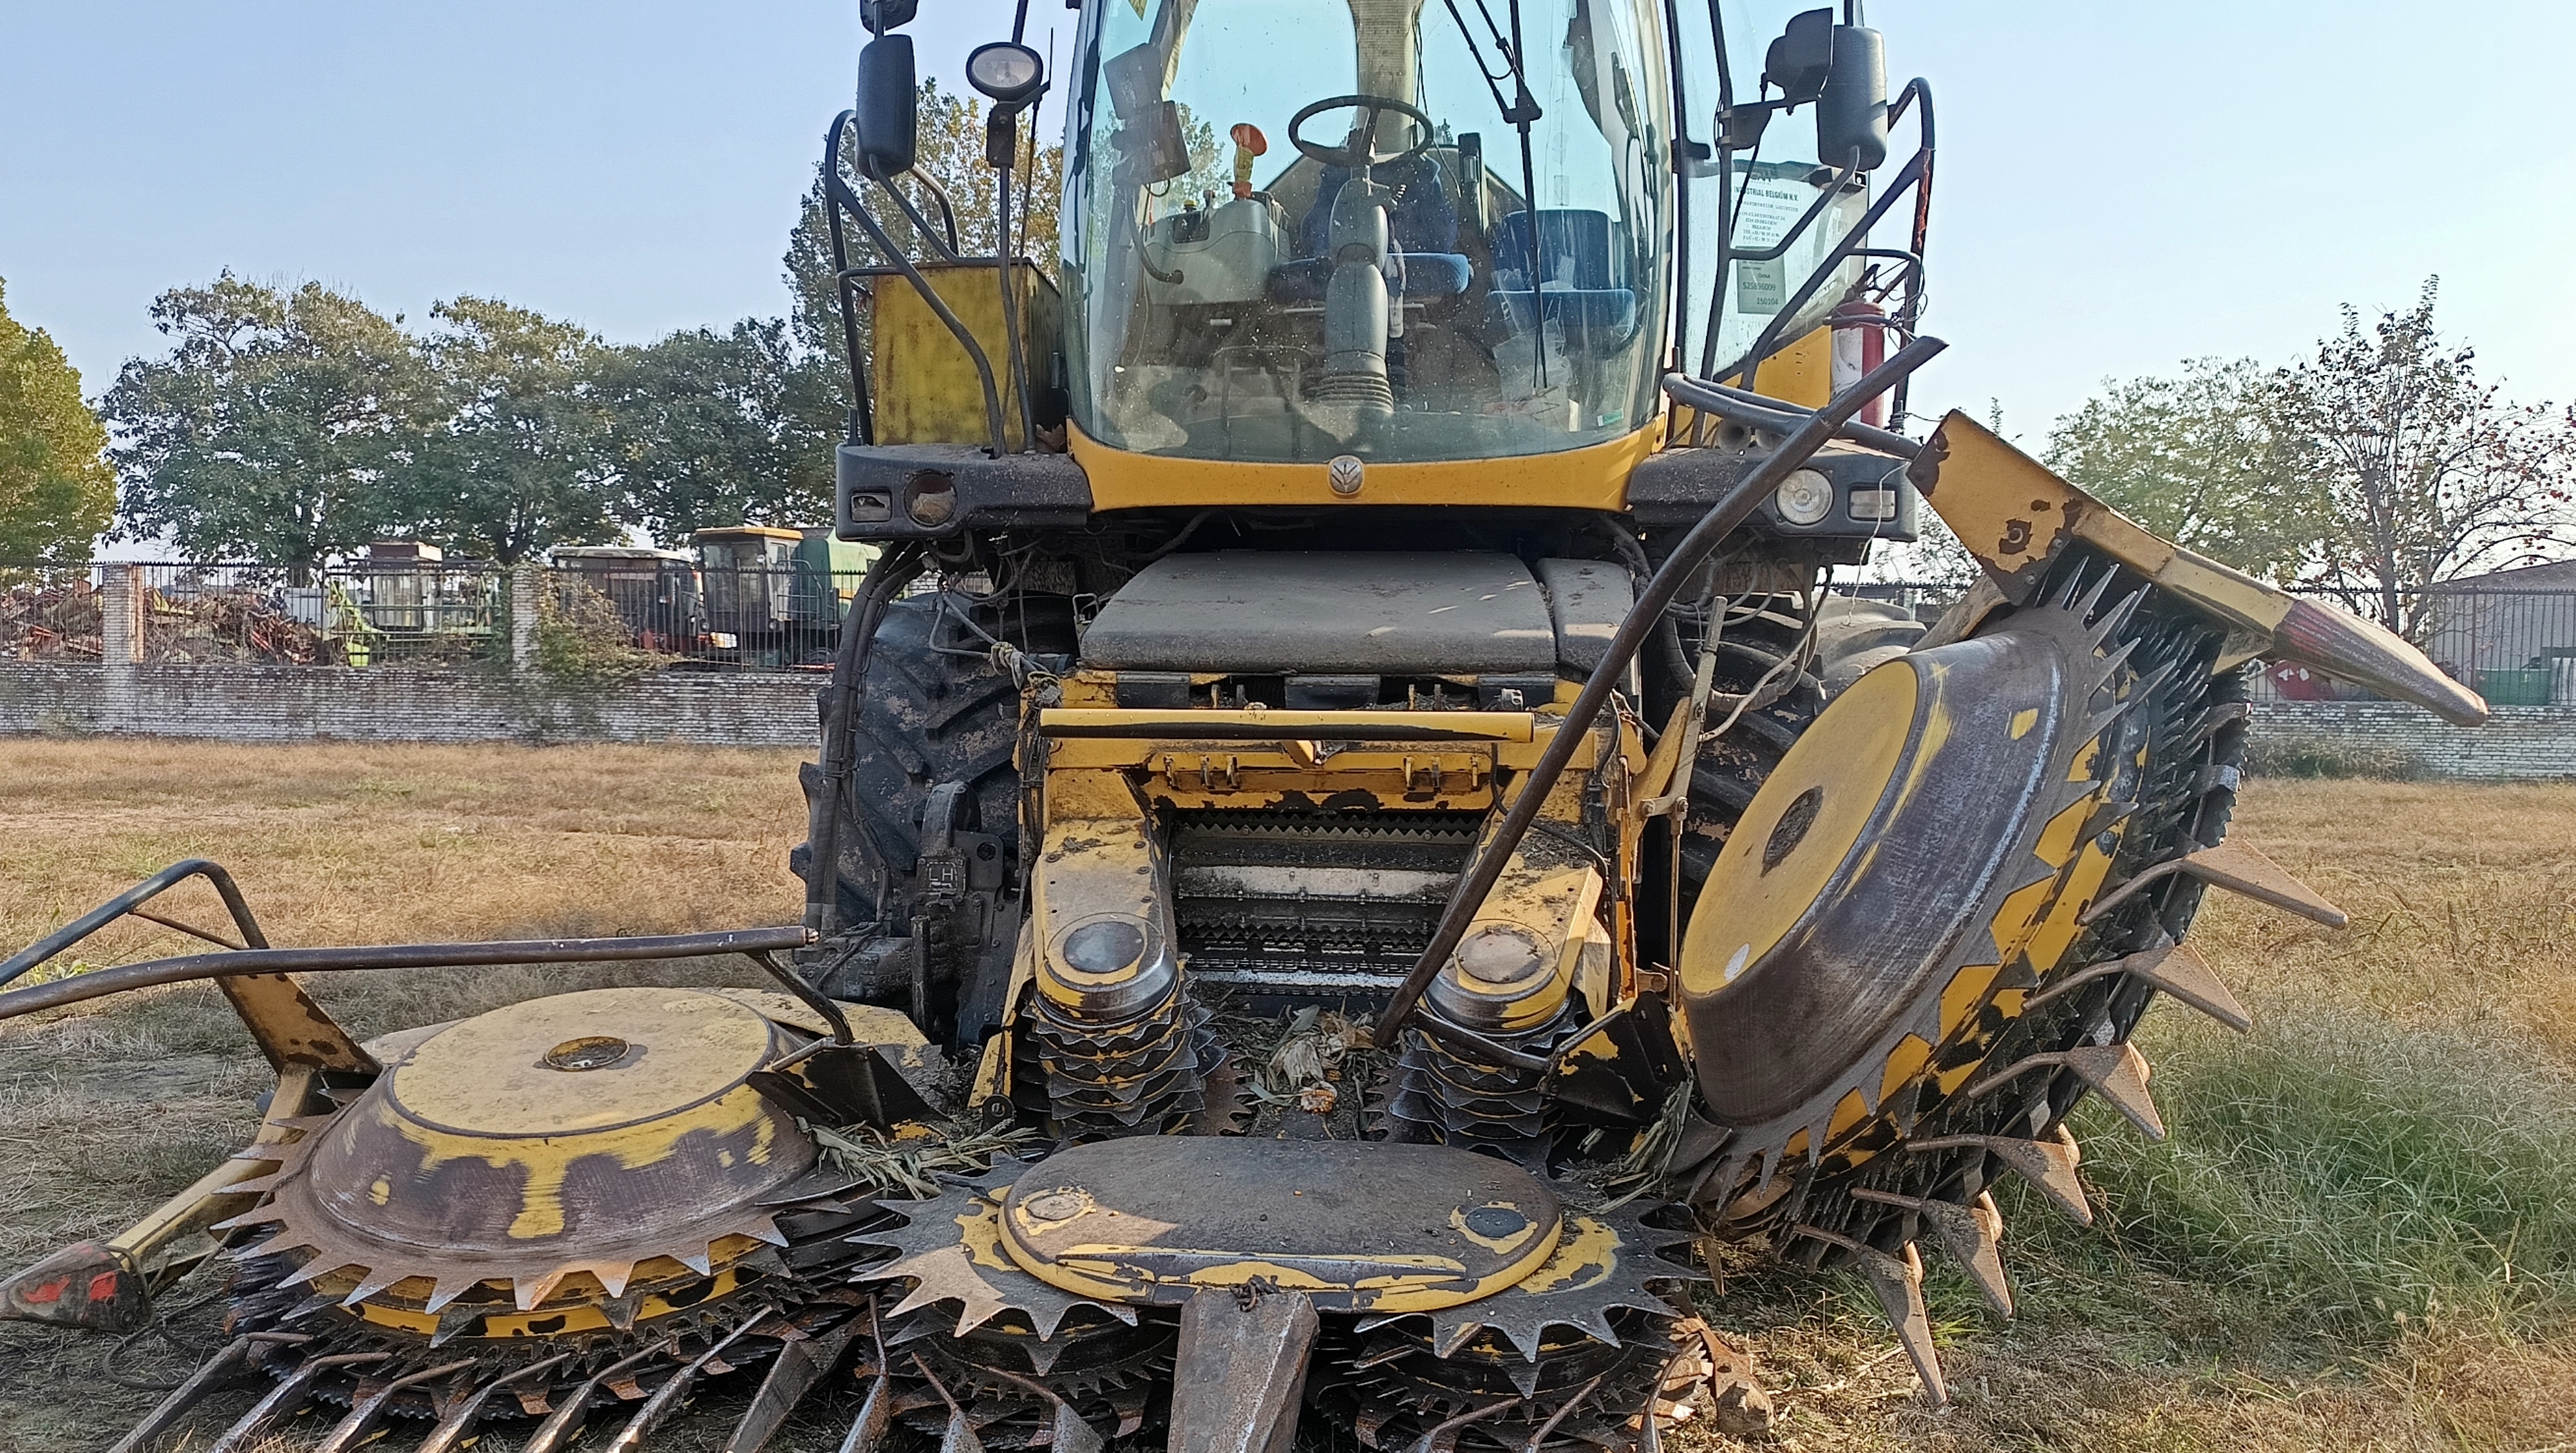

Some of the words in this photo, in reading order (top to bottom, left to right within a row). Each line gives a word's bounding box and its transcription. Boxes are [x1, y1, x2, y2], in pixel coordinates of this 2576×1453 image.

[1734, 185, 1764, 196] INSTRIAL
[1757, 297, 1779, 305] 150104
[929, 868, 953, 881] LH
